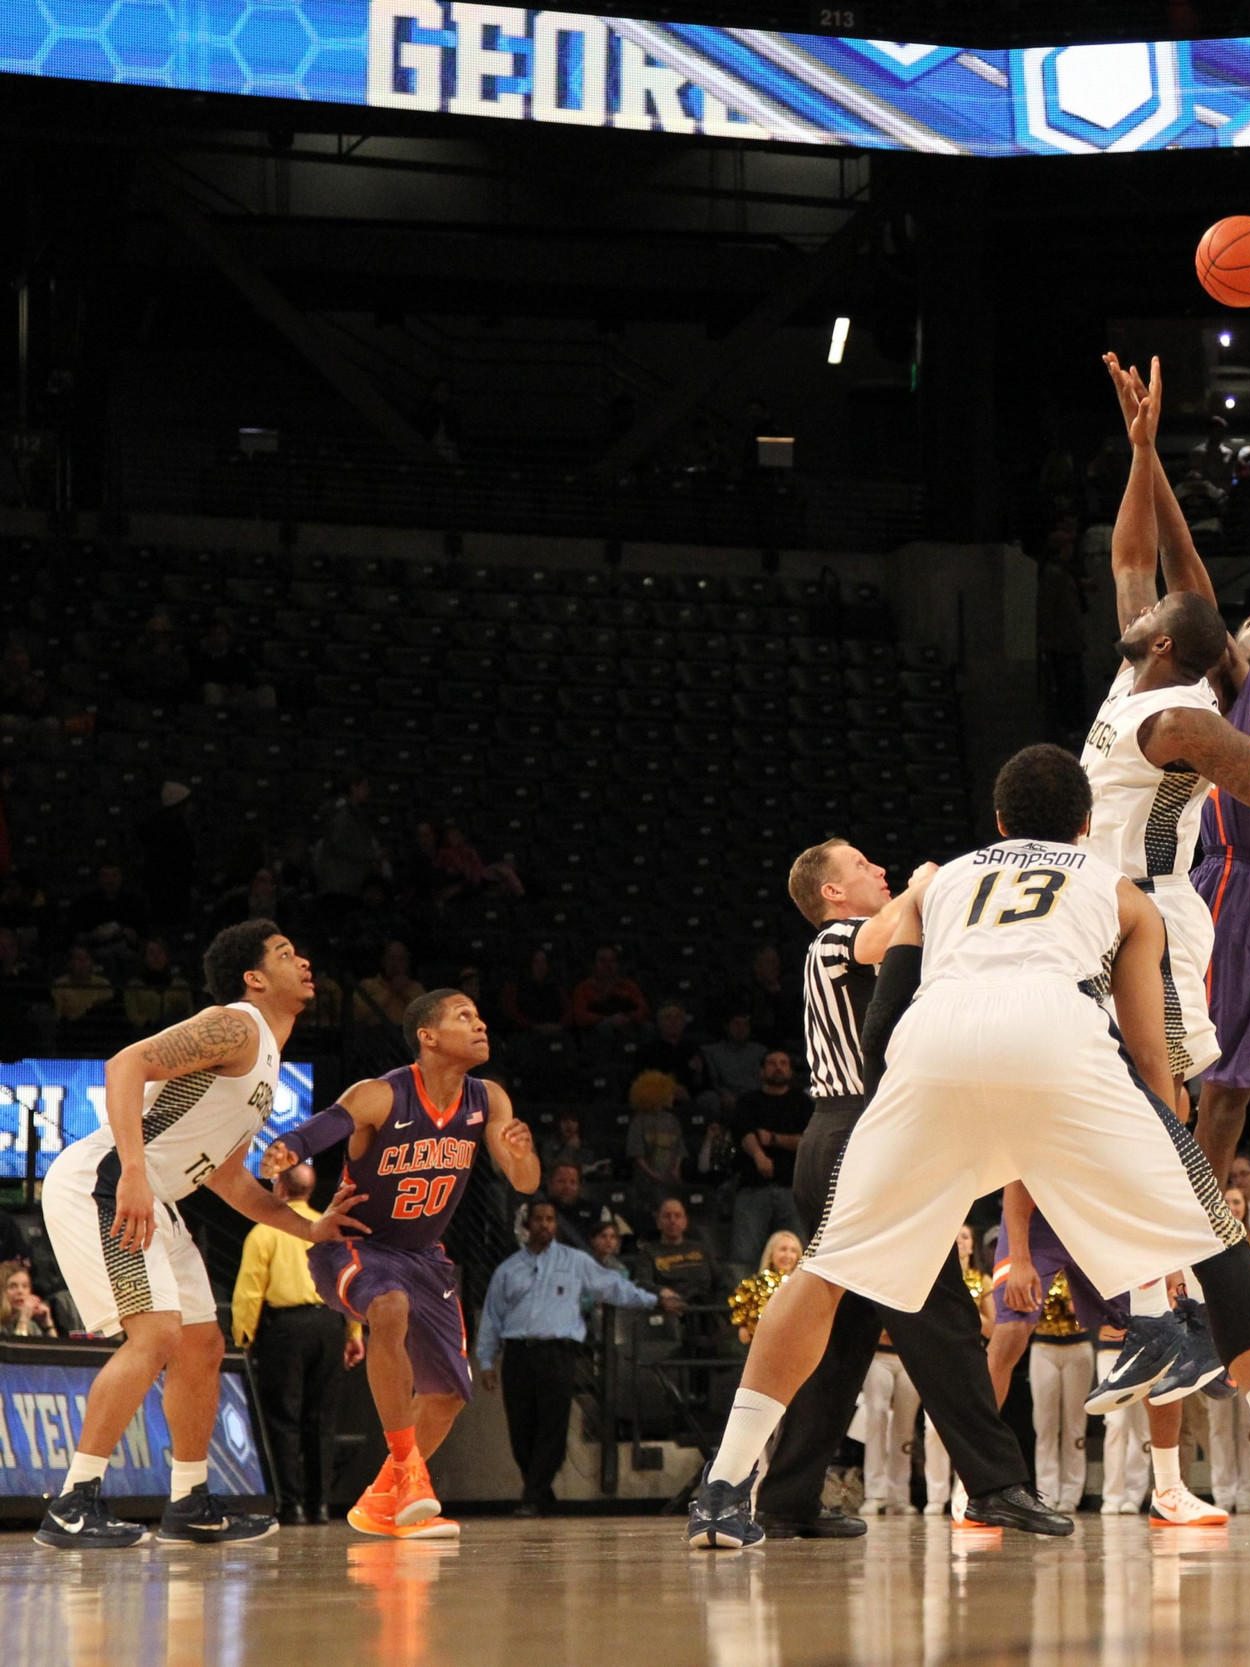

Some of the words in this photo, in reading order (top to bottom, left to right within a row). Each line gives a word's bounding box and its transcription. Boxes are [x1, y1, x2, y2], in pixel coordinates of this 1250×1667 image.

[820, 8, 855, 27] 213
[973, 848, 1087, 869] SAMPSON
[962, 867, 1071, 930] 13
[377, 1136, 476, 1176] CLEMSON
[391, 1174, 457, 1219] 20
